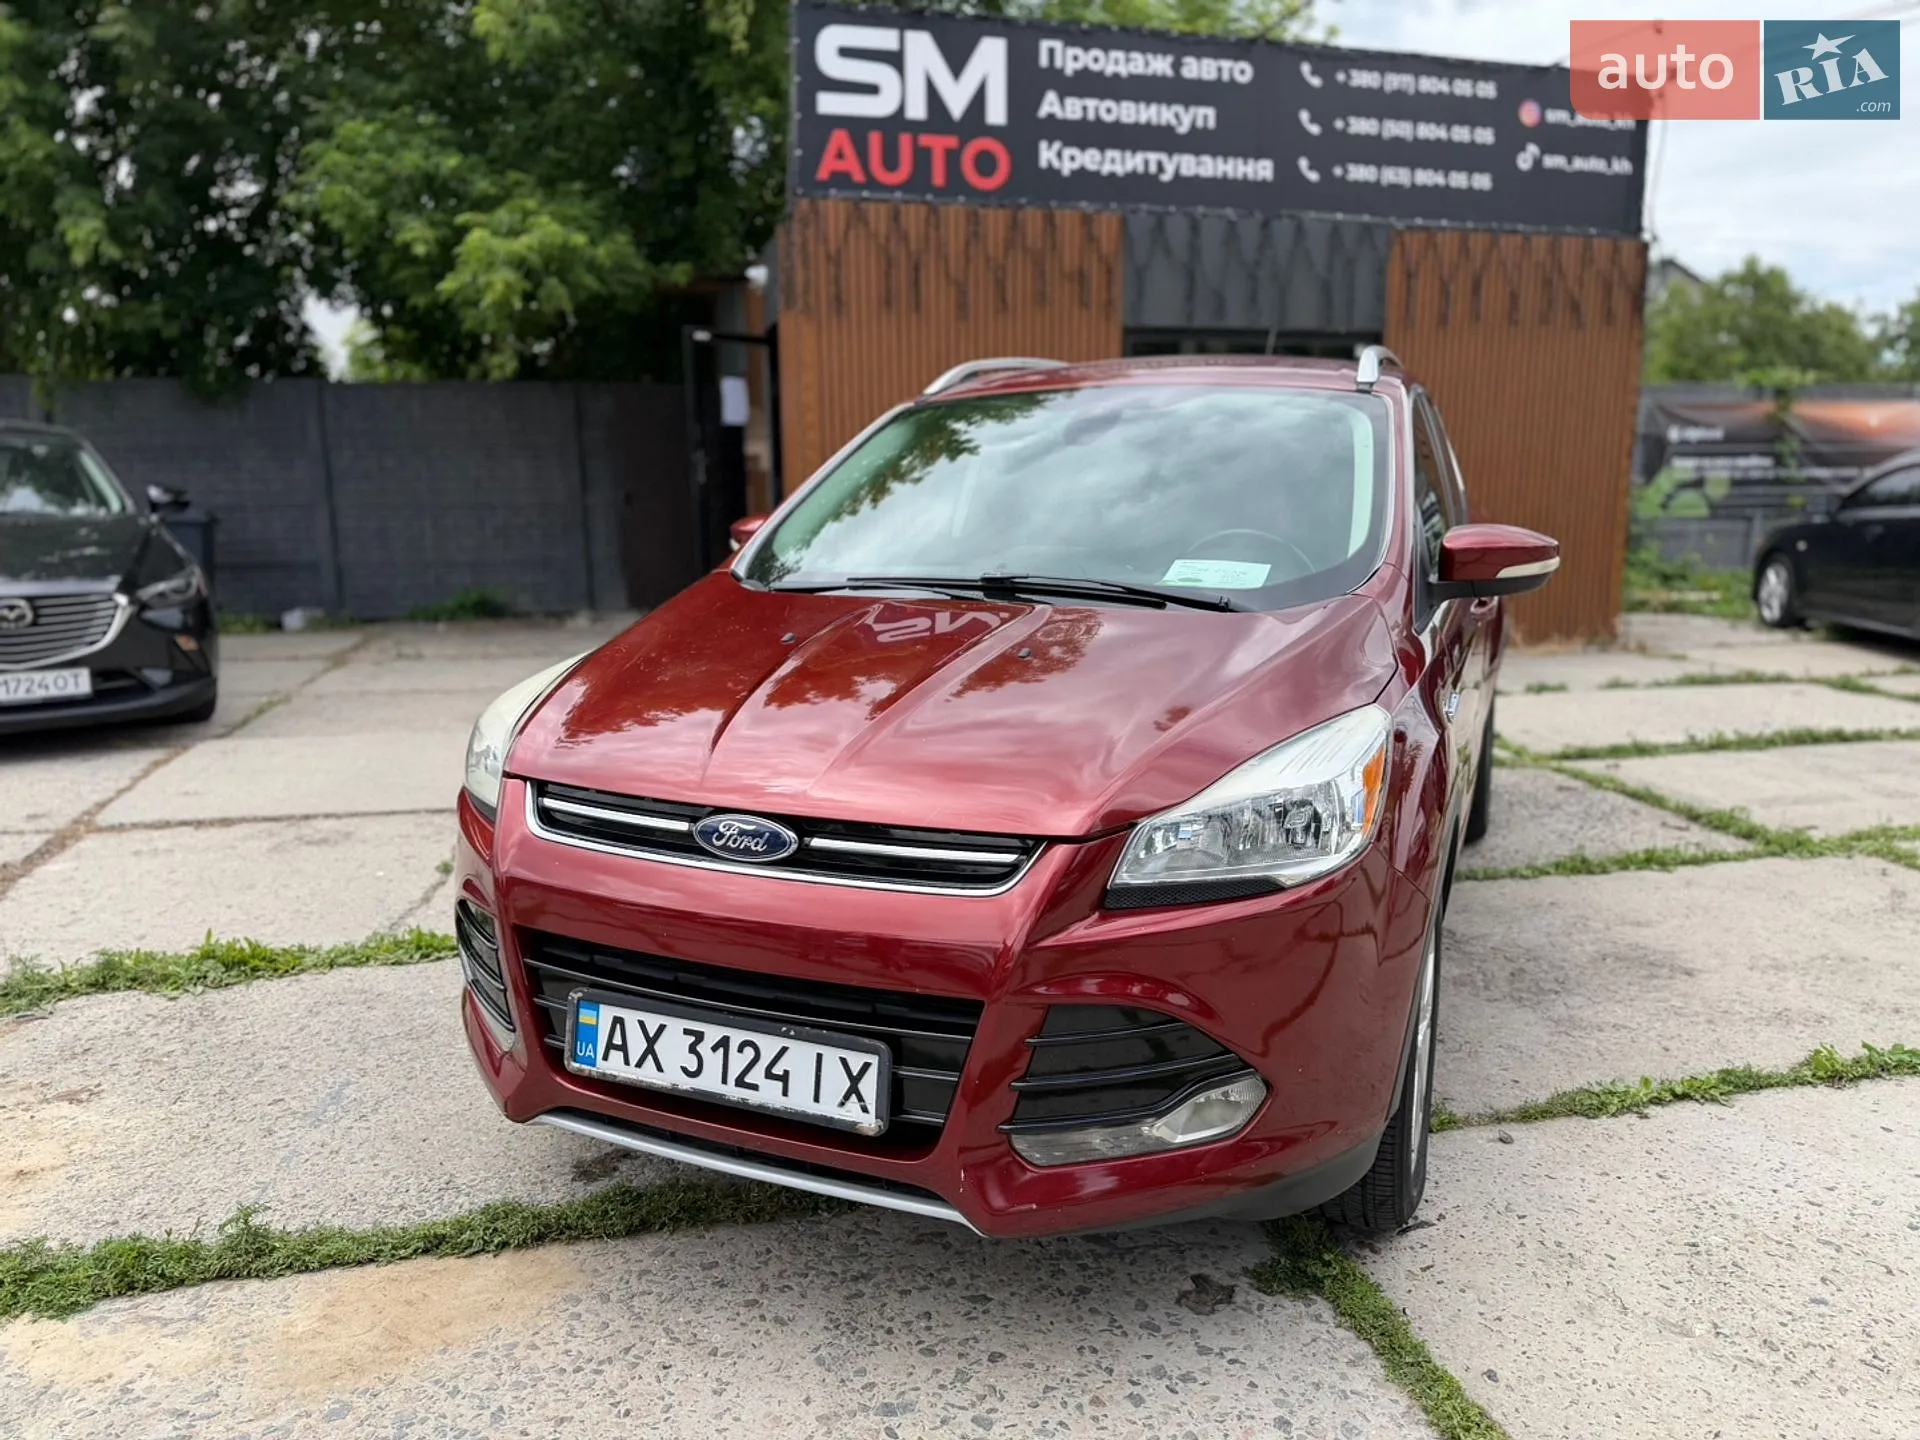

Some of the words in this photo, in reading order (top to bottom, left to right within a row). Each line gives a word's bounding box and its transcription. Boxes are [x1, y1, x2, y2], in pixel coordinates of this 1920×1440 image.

[814, 23, 1008, 127] SM
[1038, 39, 1175, 78] Продаж
[1180, 56, 1255, 85] авто
[1037, 91, 1217, 134] Автовикуп
[815, 128, 1012, 192] AUTO
[1038, 140, 1275, 182] Кредитування
[2, 675, 50, 695] 1724
[53, 672, 83, 692] OT
[711, 820, 768, 851] Ford
[576, 1041, 595, 1059] UA
[601, 1014, 667, 1074] AX
[680, 1027, 791, 1098] 3124
[812, 1051, 873, 1114] IX
